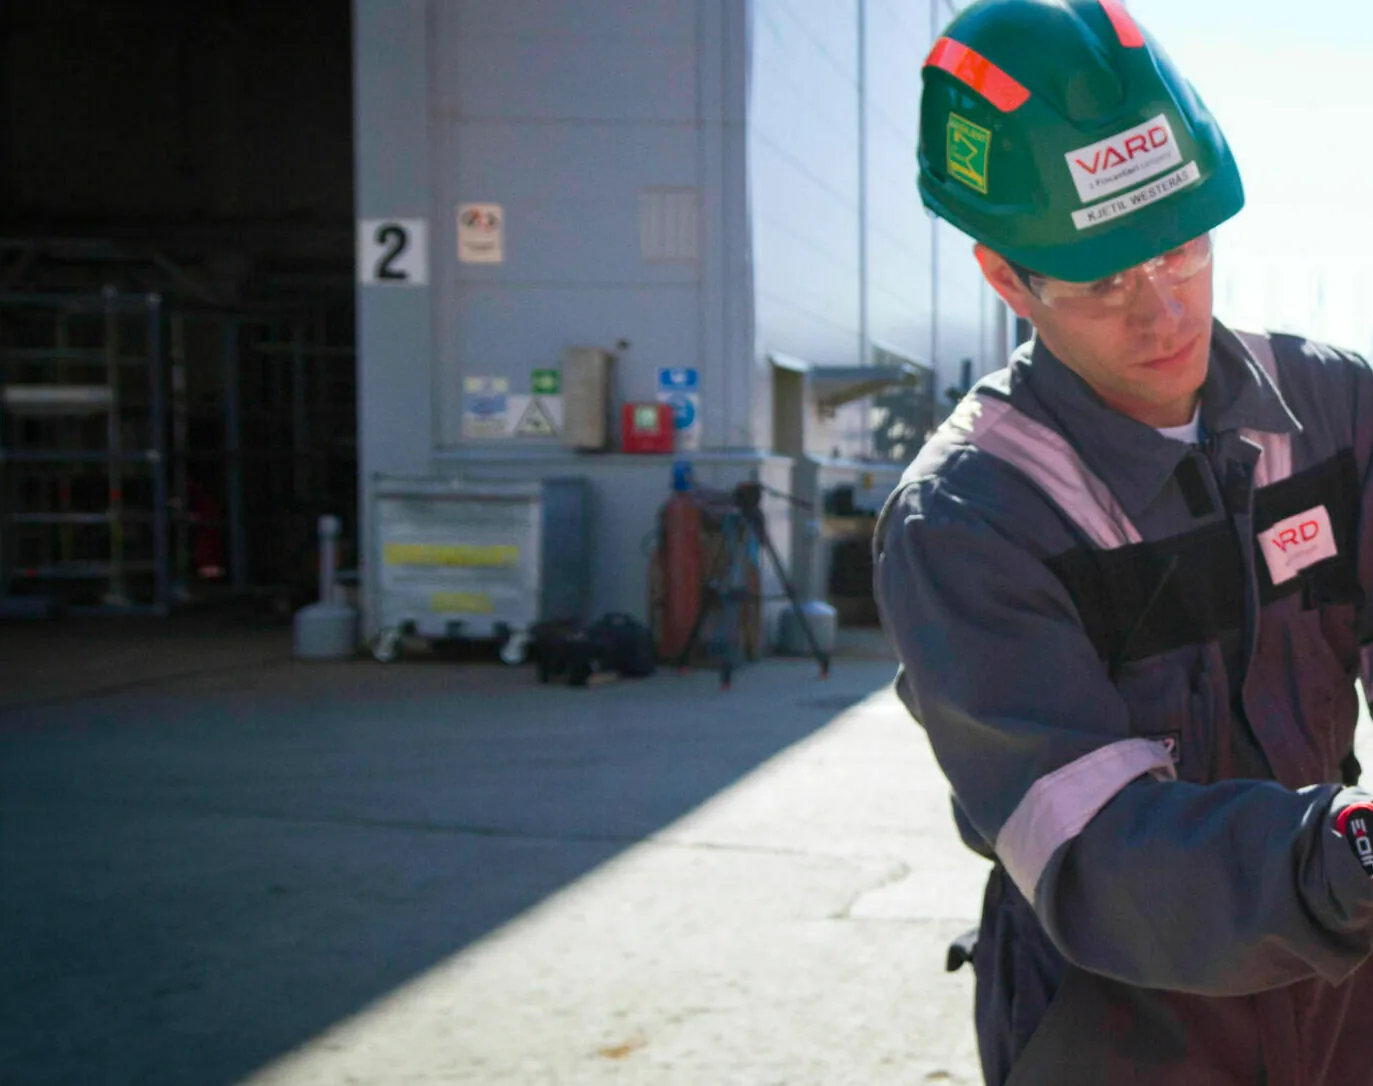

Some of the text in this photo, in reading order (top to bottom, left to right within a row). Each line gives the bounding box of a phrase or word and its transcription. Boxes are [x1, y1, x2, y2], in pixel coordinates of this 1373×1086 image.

[1074, 126, 1169, 175] VARD
[1087, 201, 1126, 222] KJETIL
[376, 222, 408, 280] 2
